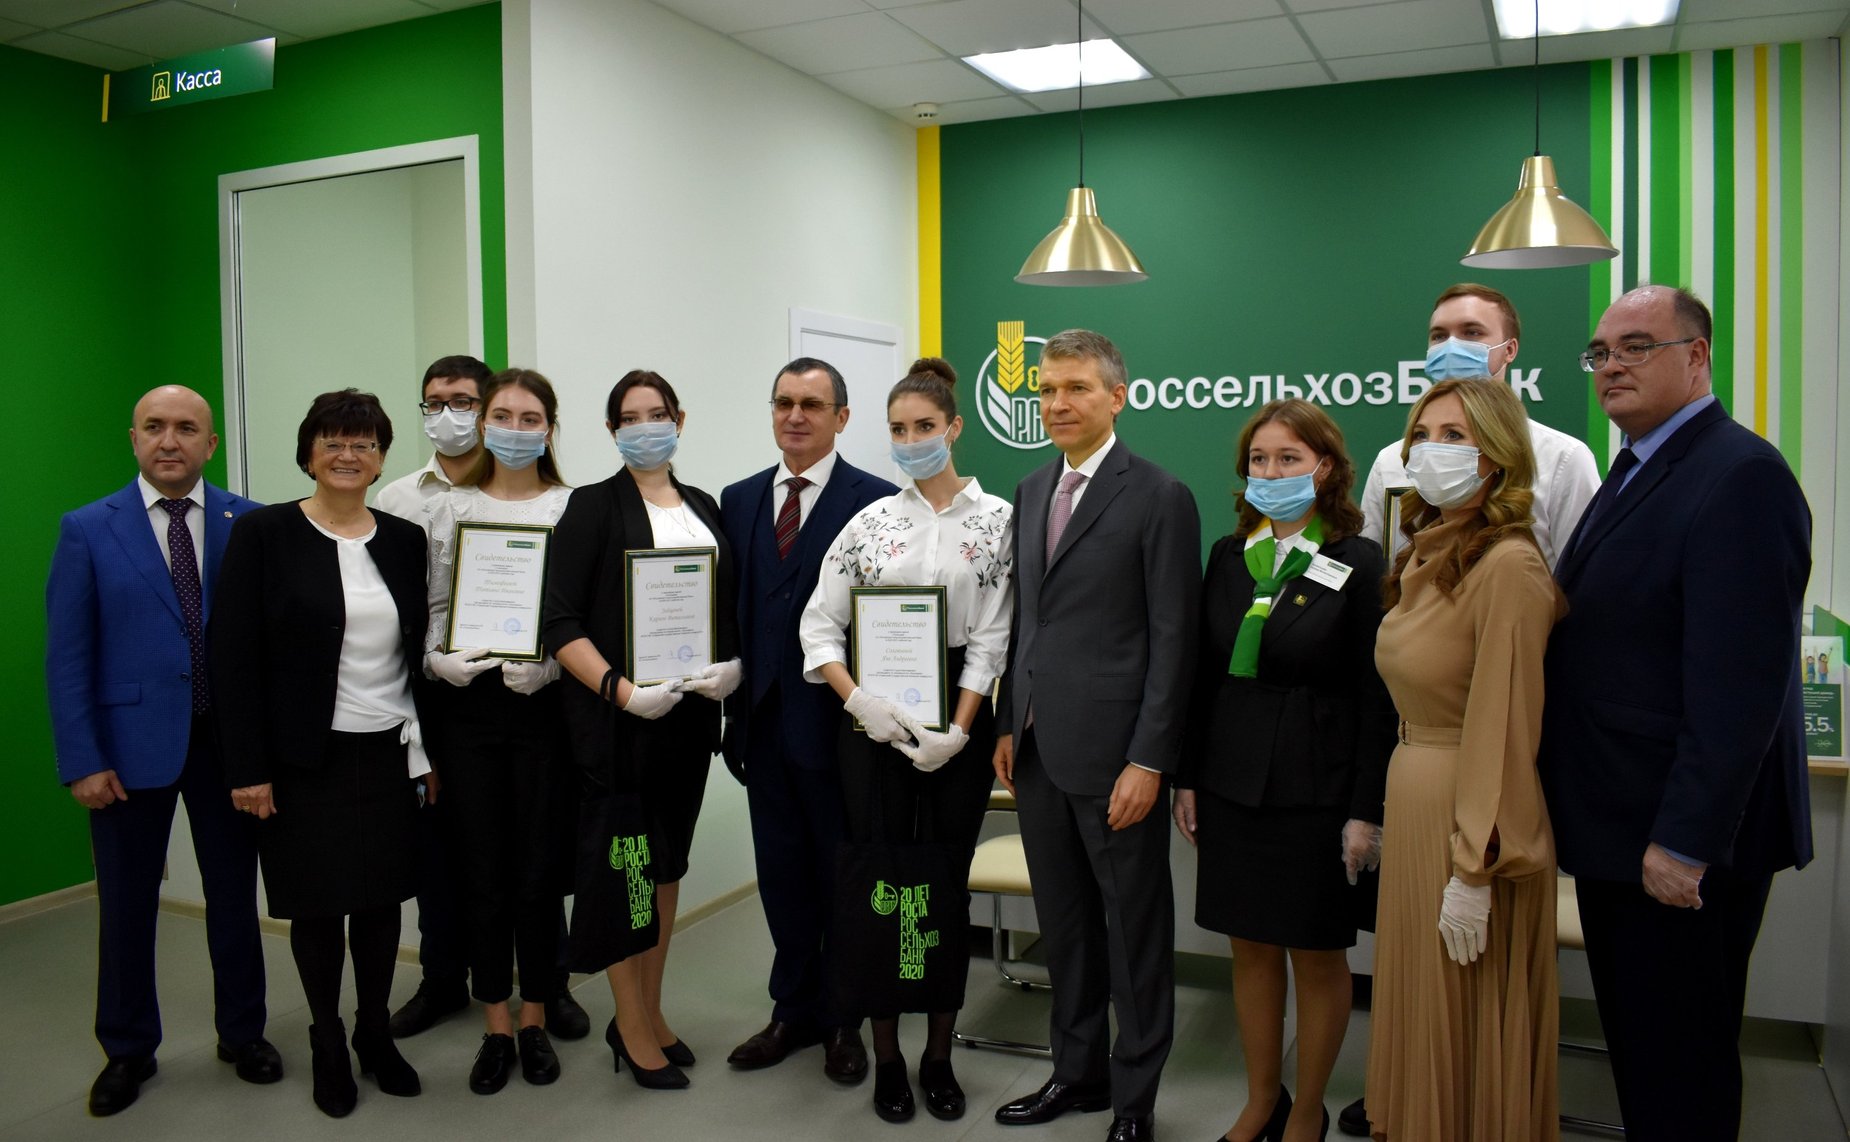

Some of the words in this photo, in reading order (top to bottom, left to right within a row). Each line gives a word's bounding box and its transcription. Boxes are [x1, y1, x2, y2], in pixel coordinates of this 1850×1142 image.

[176, 69, 222, 93] Касса
[1127, 360, 1544, 410] оссельхозБк
[622, 837, 635, 853] 20
[626, 866, 643, 883] РОС
[900, 886, 912, 902] 20
[914, 884, 930, 902] ЛЕТ
[629, 895, 652, 914] БАНК
[900, 901, 928, 918] РОСТА
[631, 910, 652, 930] 2020
[900, 916, 918, 934] РОС
[900, 930, 940, 949] СЕЛЬХОЗ
[900, 947, 925, 964] БАНК
[899, 963, 925, 980] 2020
